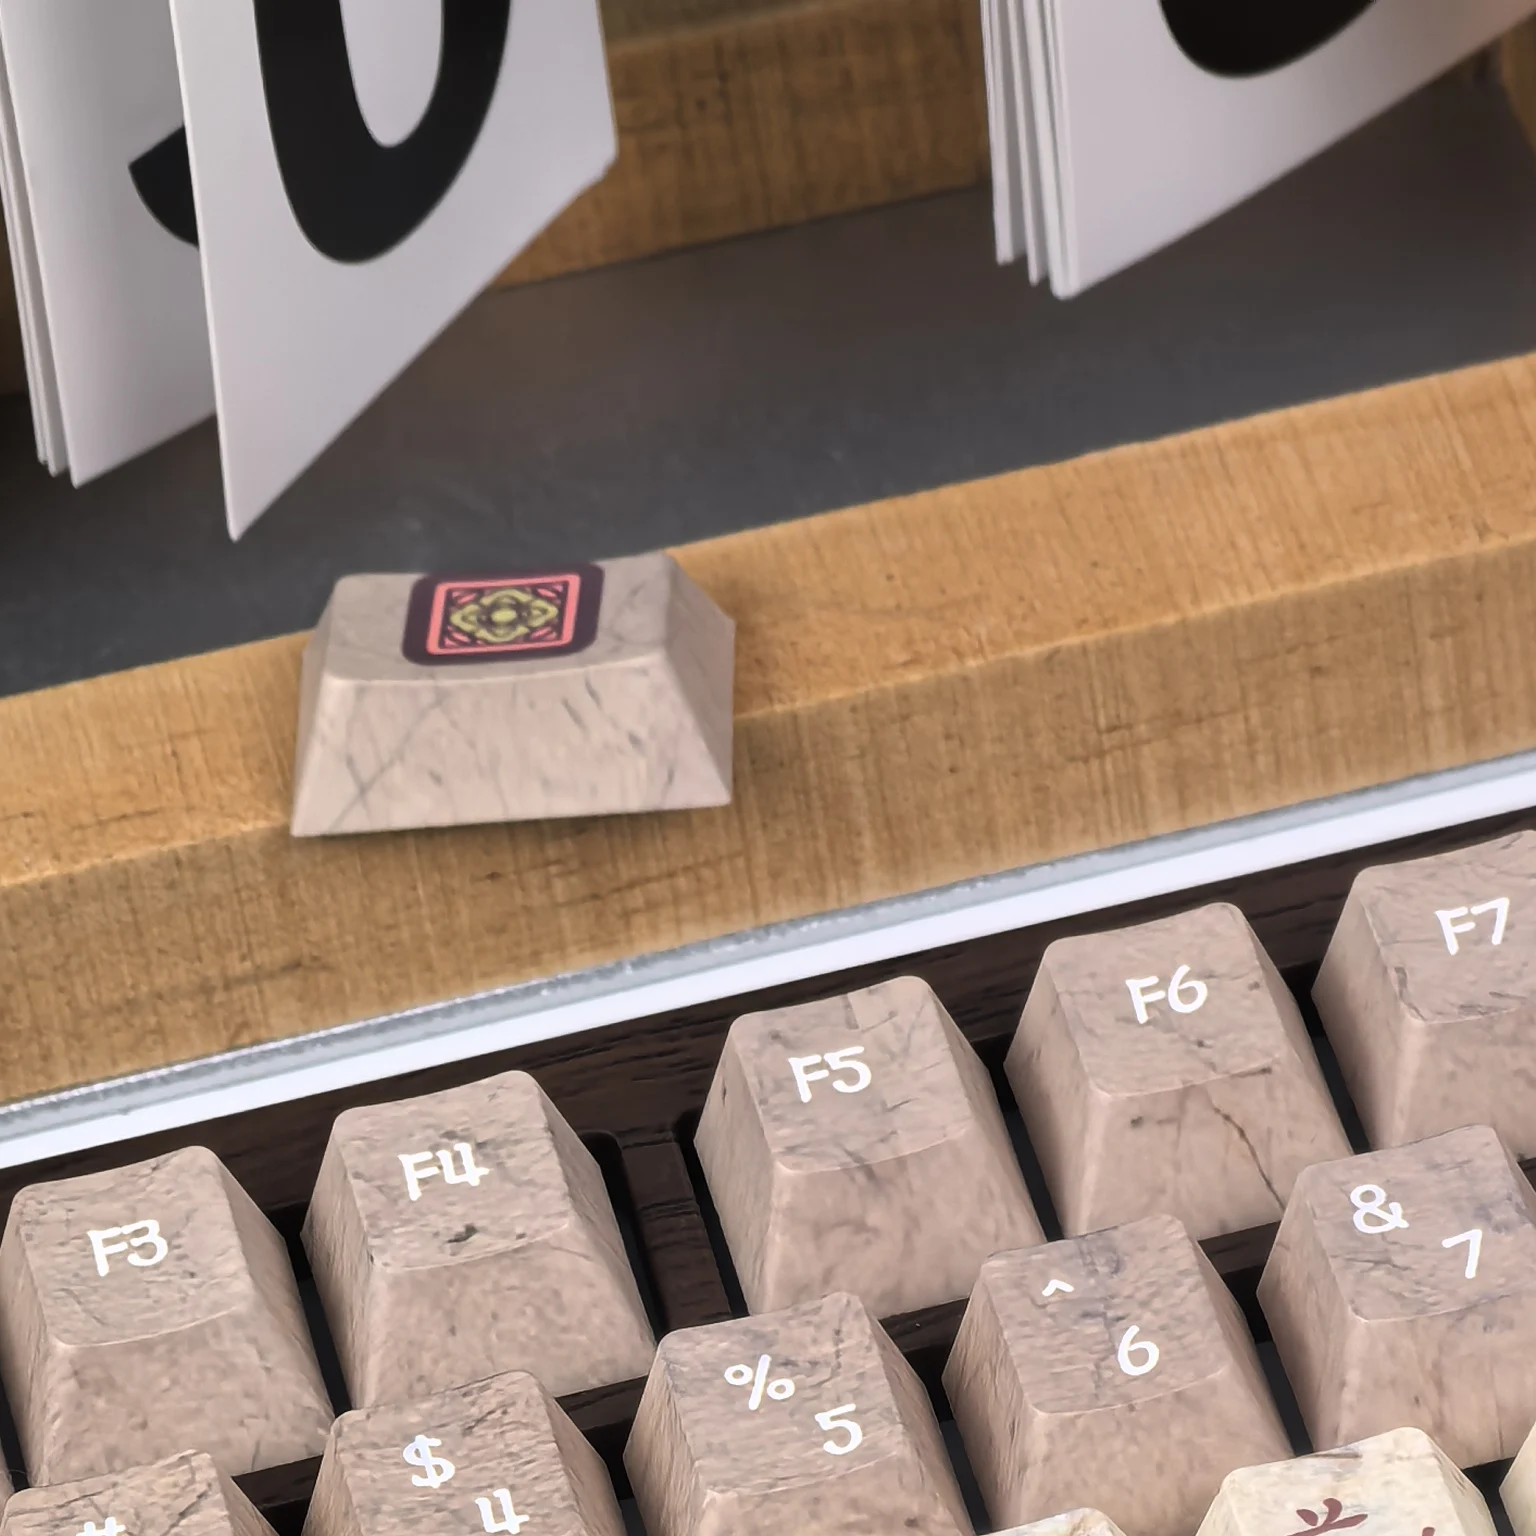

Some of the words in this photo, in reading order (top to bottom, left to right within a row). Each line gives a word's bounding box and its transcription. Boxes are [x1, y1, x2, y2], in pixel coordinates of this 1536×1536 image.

[1433, 896, 1511, 957] F7
[1124, 963, 1209, 1025] F6
[786, 1044, 873, 1104] F5
[396, 1141, 491, 1203] F4
[1348, 1182, 1411, 1235] &
[85, 1218, 169, 1278] F3
[1440, 1227, 1484, 1280] 7
[1116, 1323, 1161, 1377] 6
[722, 1353, 796, 1412] %
[813, 1402, 864, 1456] 5
[401, 1433, 457, 1490] $
[473, 1486, 531, 1536] 4
